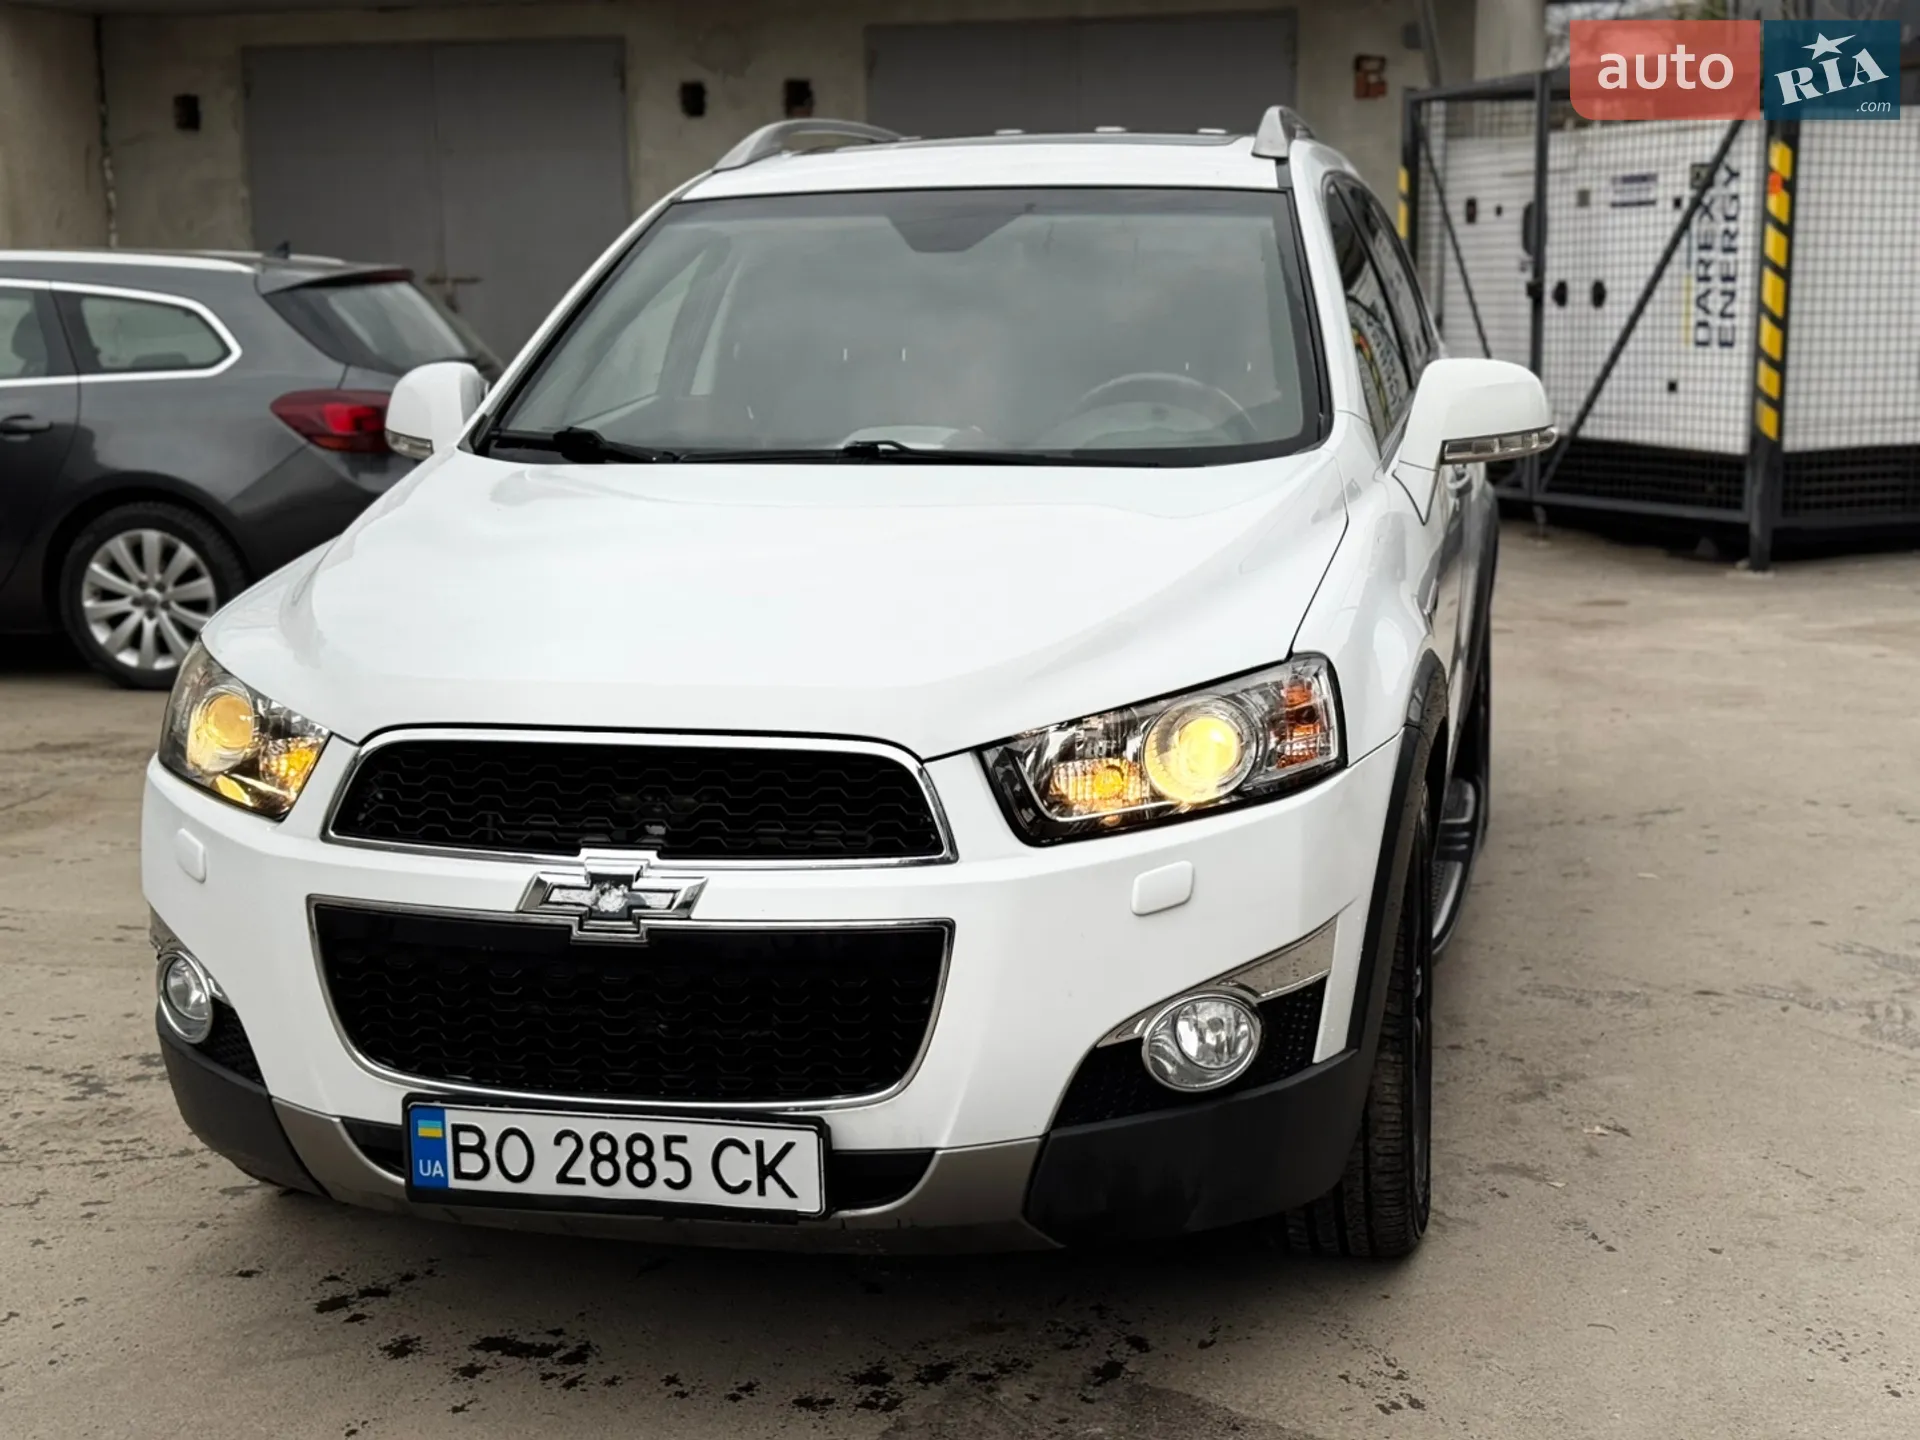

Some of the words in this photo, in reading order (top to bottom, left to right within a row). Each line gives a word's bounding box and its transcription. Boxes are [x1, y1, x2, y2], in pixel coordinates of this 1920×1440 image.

[1717, 162, 1741, 348] ENERGY
[418, 1159, 445, 1178] UA
[450, 1123, 535, 1184] BO
[553, 1128, 693, 1190] 2885
[711, 1137, 799, 1199] CK
